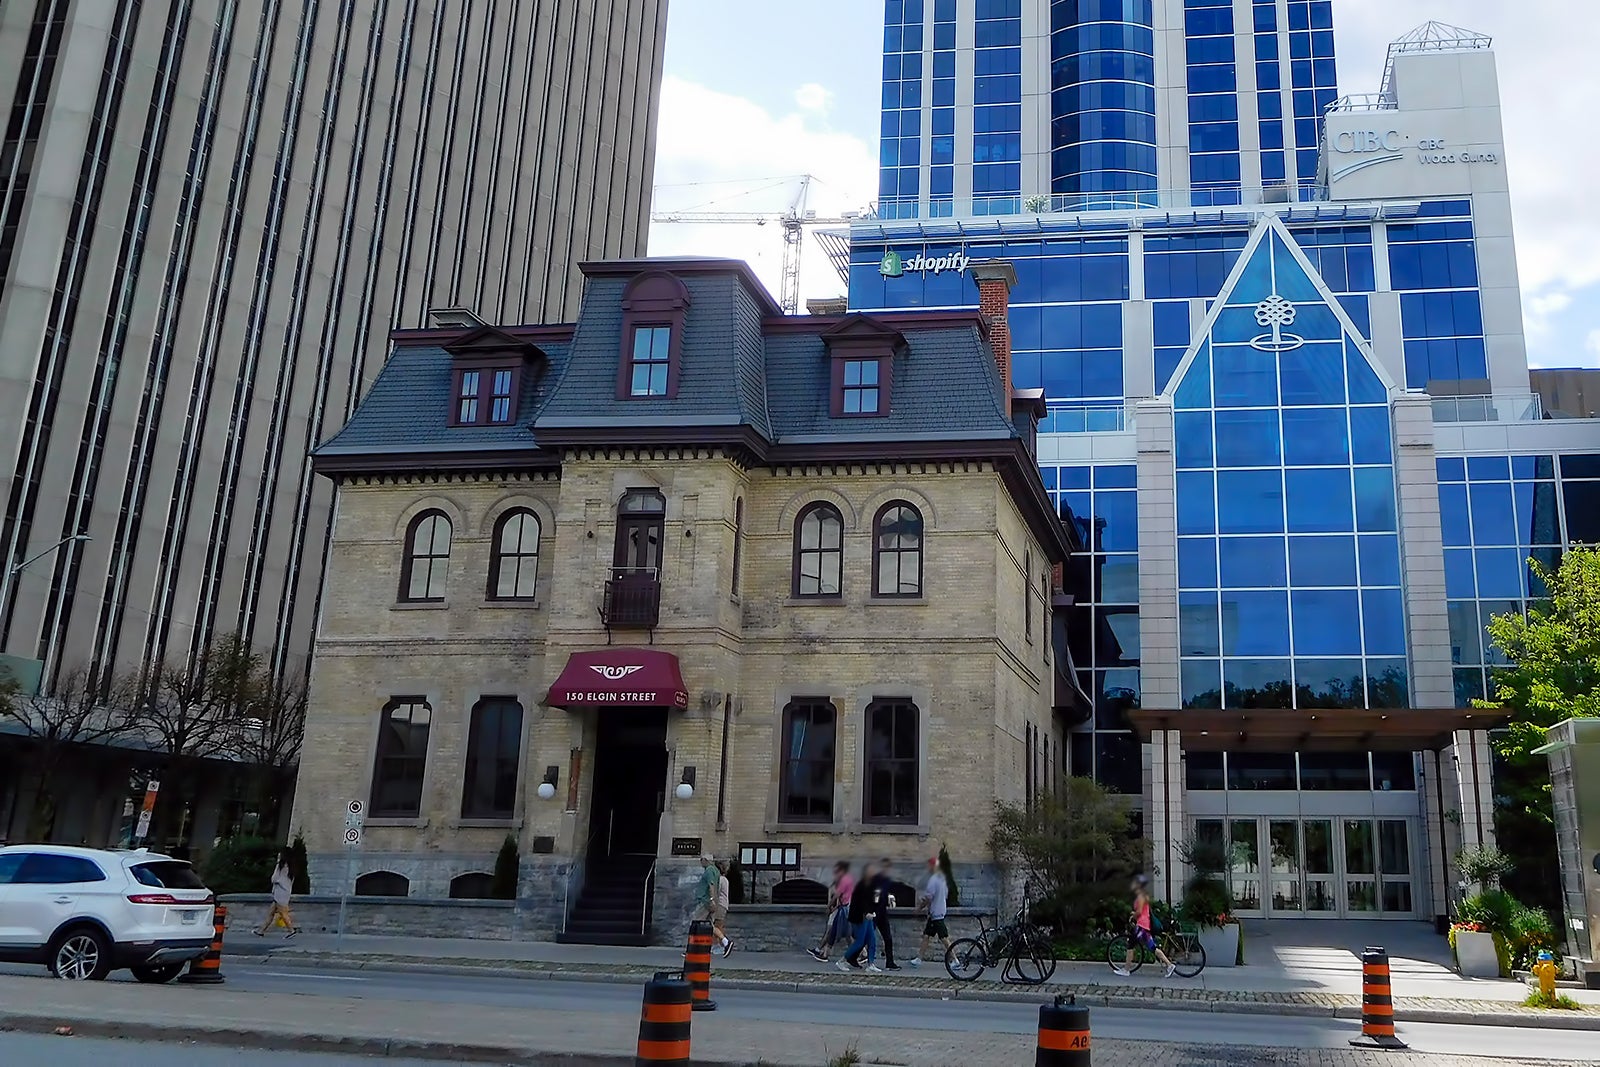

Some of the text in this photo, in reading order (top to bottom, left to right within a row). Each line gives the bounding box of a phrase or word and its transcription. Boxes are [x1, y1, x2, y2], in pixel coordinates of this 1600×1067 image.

[1333, 130, 1400, 153] CIBC
[1417, 139, 1445, 150] CIBC
[905, 252, 970, 273] shopify
[566, 692, 657, 701] 150 ELGIN STREET
